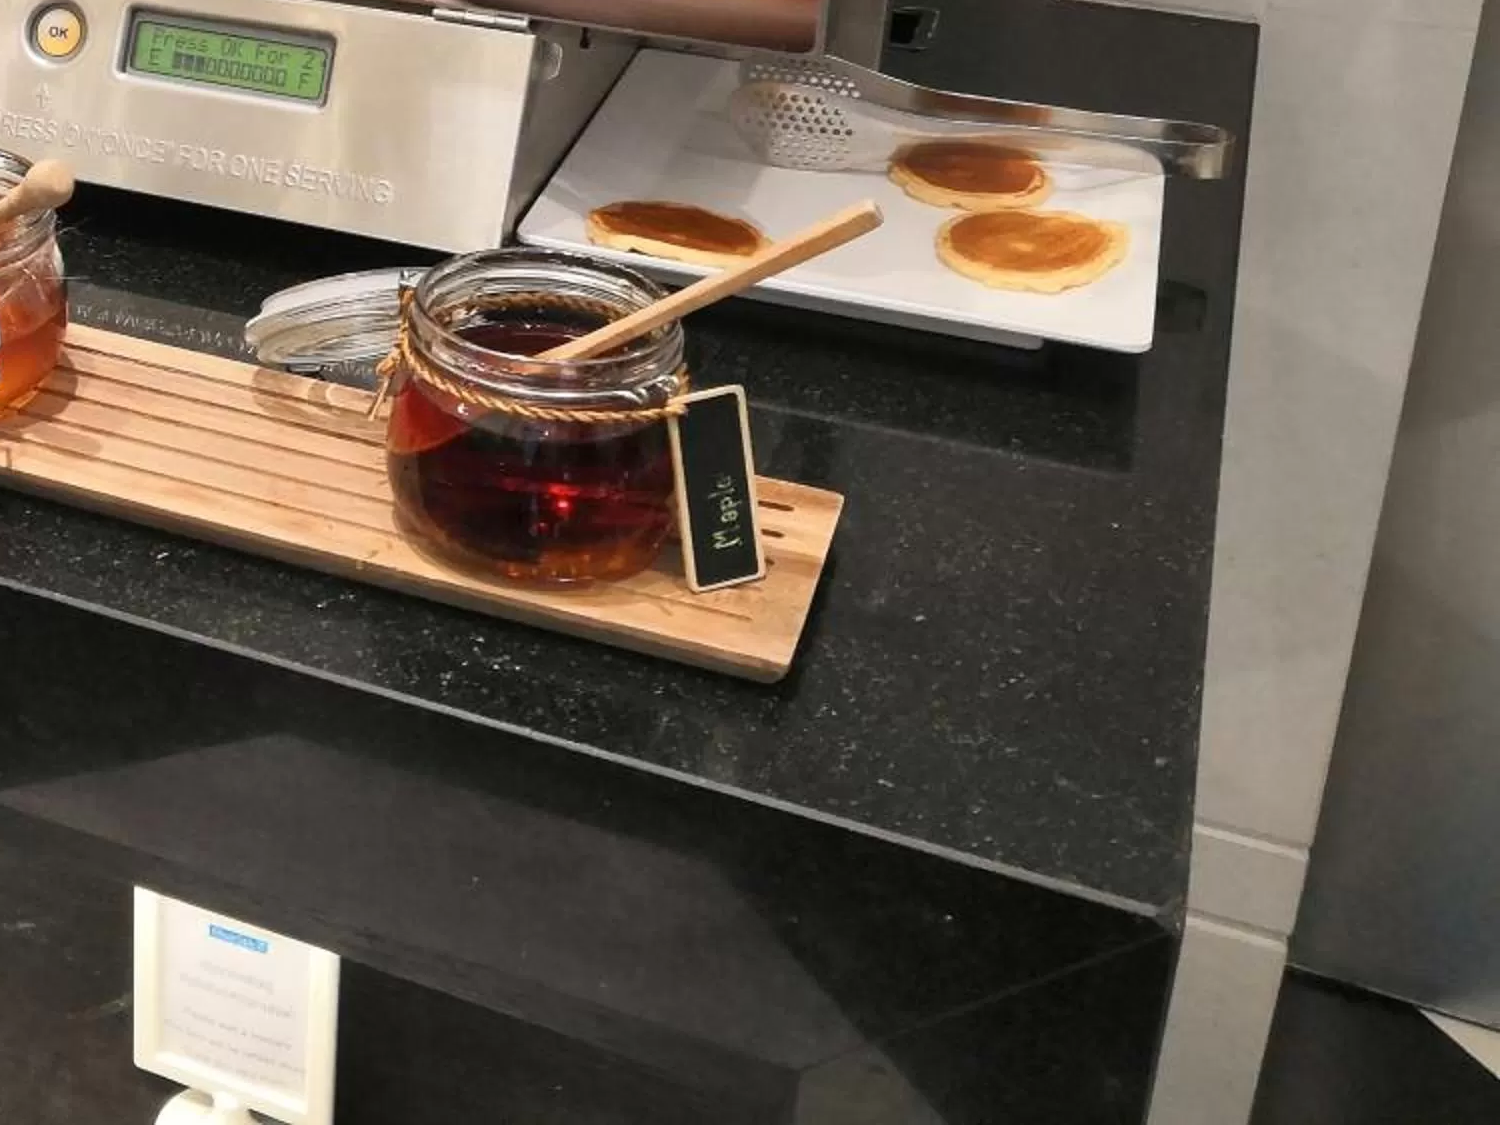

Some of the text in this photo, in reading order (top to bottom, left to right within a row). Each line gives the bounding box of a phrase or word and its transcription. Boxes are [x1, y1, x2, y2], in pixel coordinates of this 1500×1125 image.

[48, 25, 70, 40] OK
[151, 26, 209, 53] Press
[220, 38, 244, 58] OK
[302, 50, 316, 70] 2
[148, 47, 163, 66] E
[178, 141, 226, 174] FOR
[230, 153, 279, 186] ONE
[283, 162, 397, 205] SERVING
[707, 474, 744, 550] Maple
